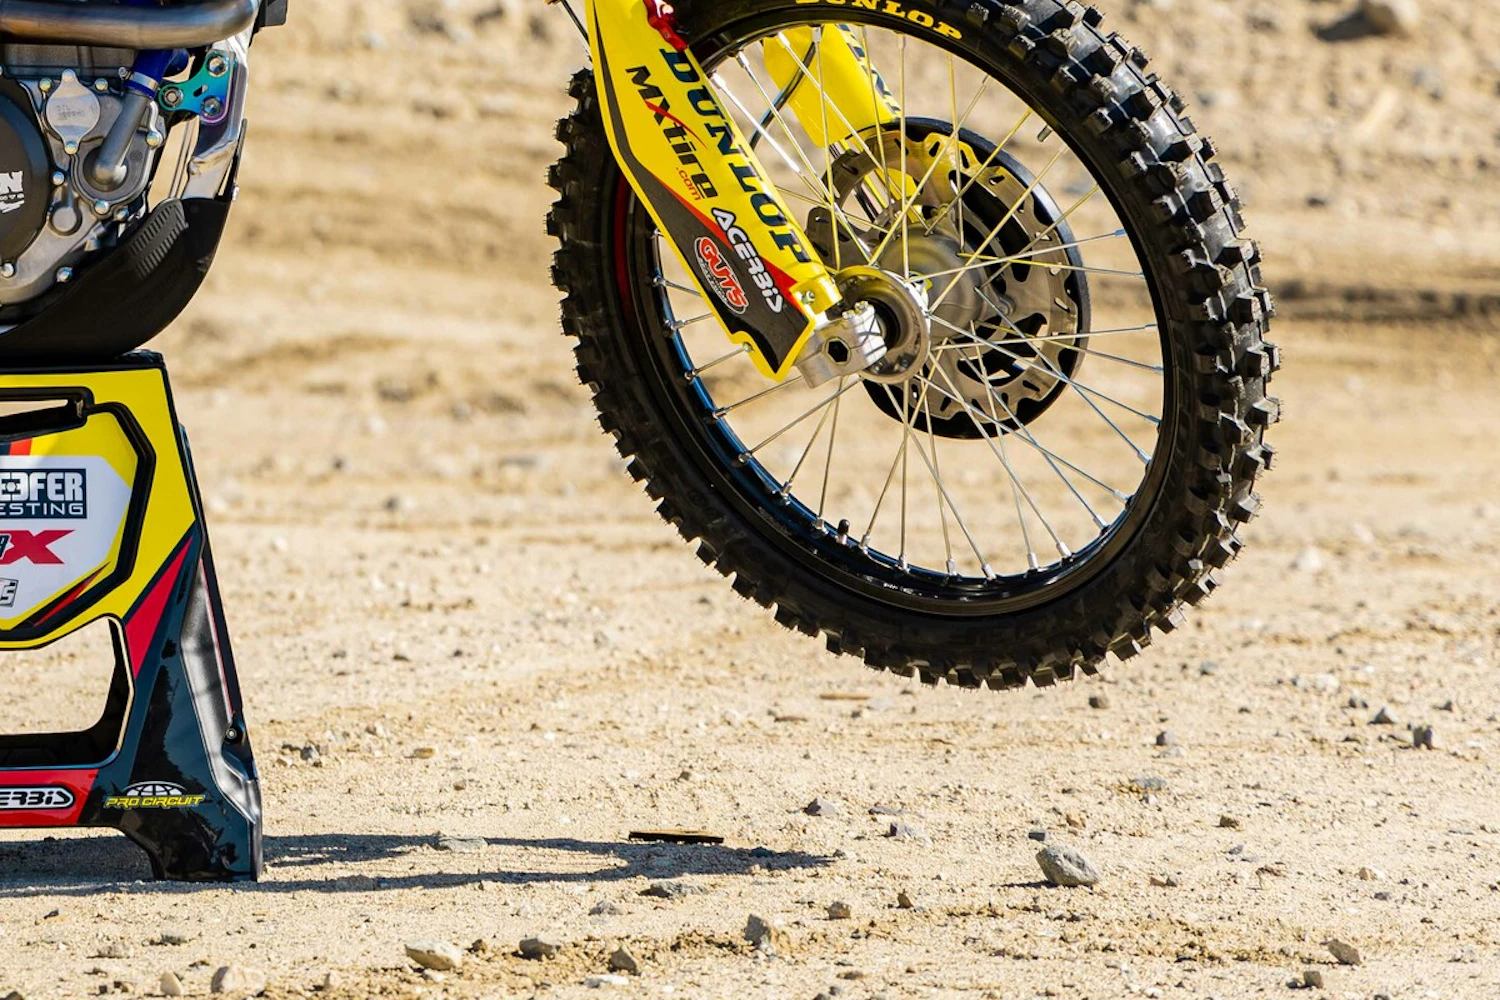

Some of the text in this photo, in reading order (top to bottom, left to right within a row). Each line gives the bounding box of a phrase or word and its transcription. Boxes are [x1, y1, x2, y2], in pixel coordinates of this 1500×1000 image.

[625, 65, 719, 199] MXtire
[659, 49, 812, 263] DUNLOP
[676, 167, 702, 201] .com
[700, 237, 749, 308] GUTS
[712, 207, 783, 314] ACERBIS
[106, 795, 205, 809] PRO CIRCUIT
